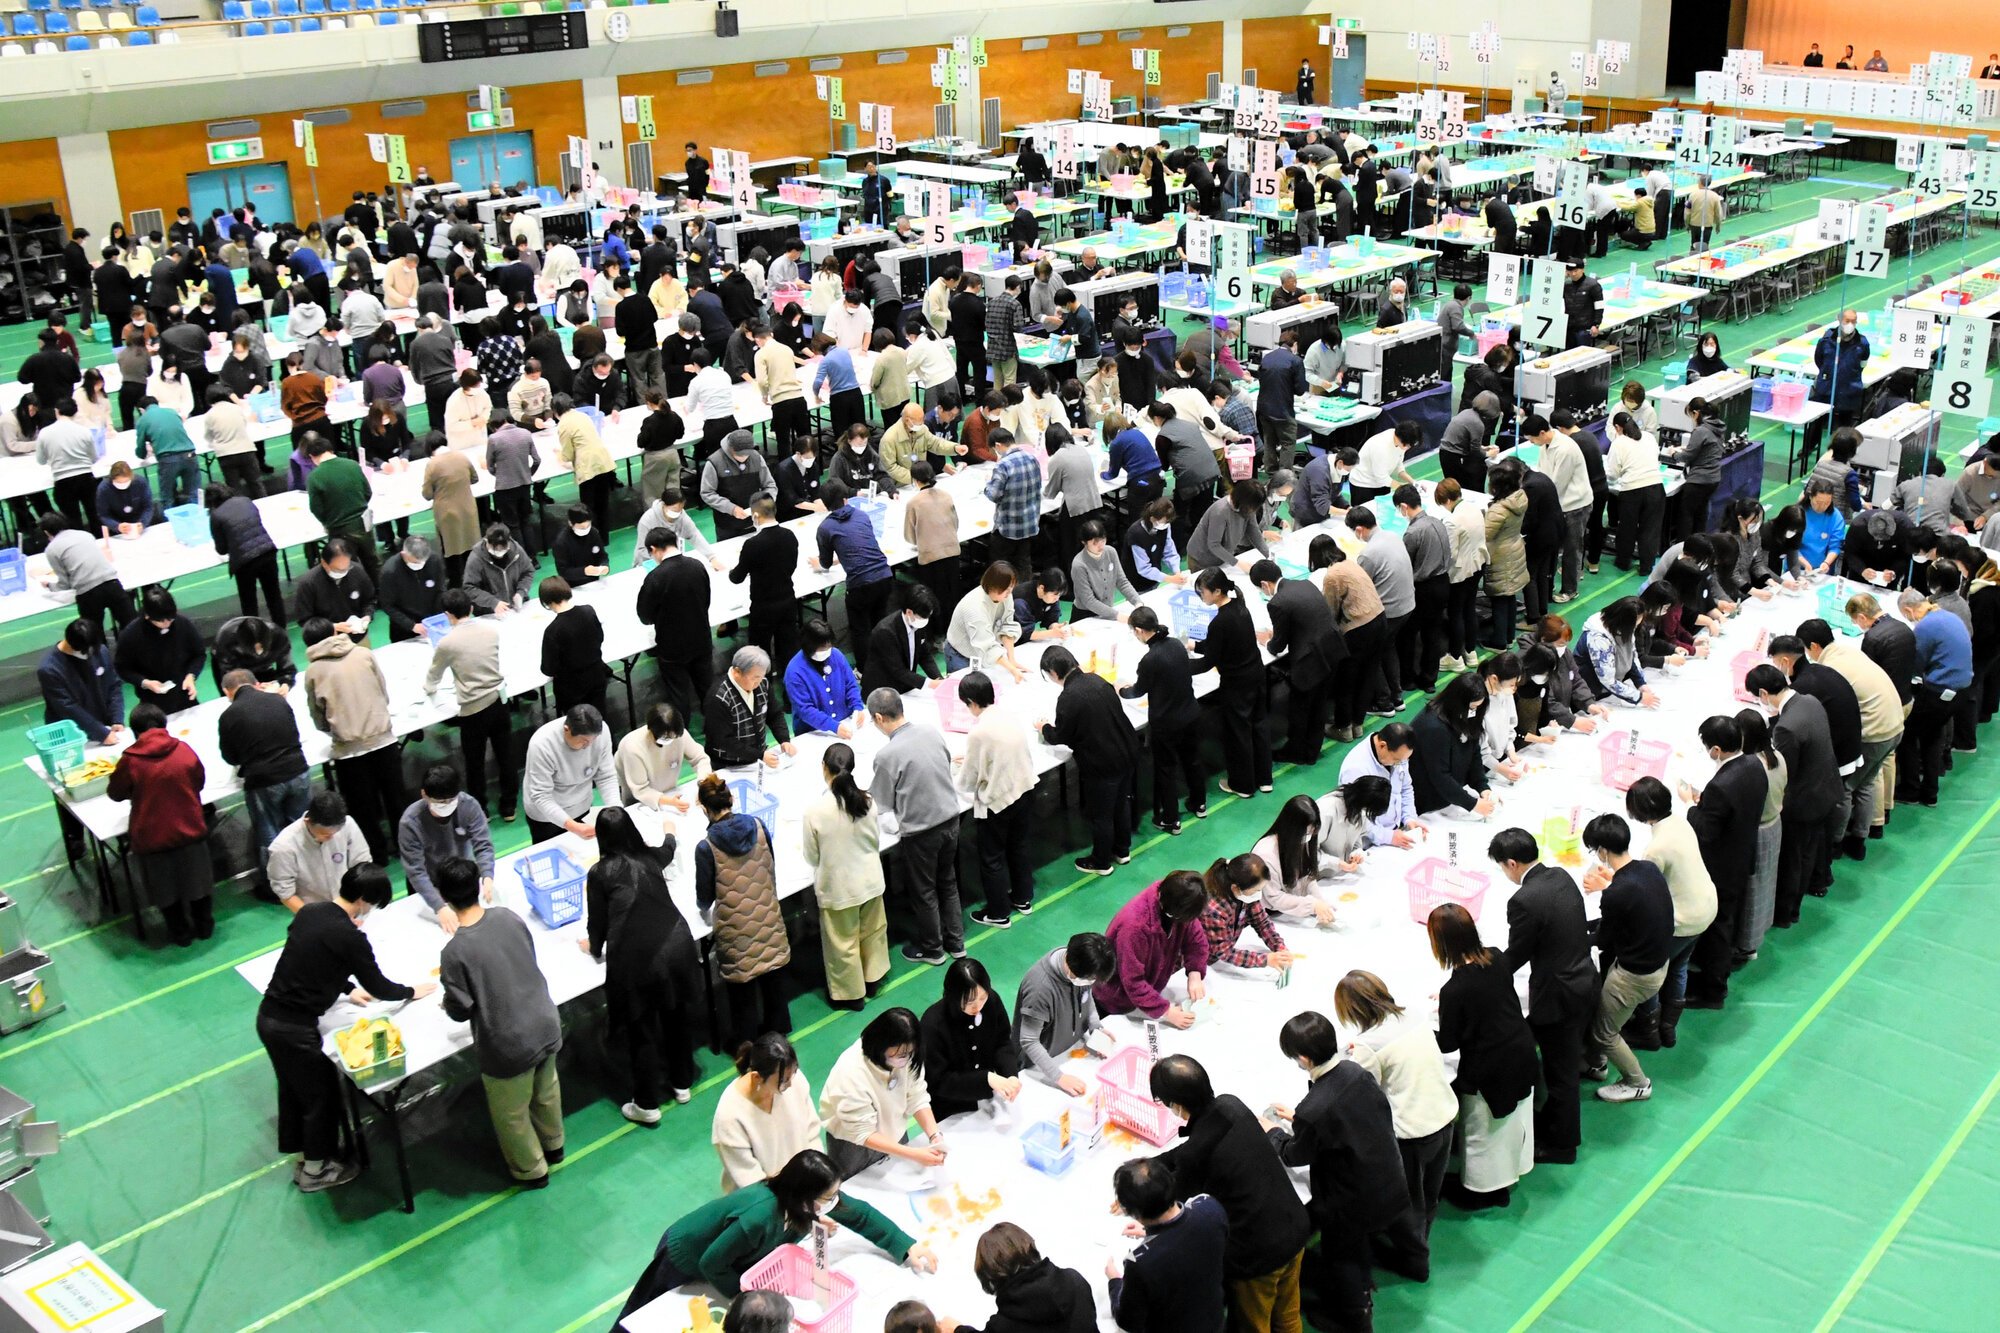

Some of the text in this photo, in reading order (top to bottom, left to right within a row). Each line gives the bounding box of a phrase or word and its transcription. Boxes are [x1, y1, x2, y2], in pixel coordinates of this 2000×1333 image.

[1335, 47, 1346, 57] 71
[1477, 53, 1490, 63] 61
[972, 55, 985, 66] 95
[1438, 60, 1449, 72] 32
[1605, 62, 1619, 73] 62
[1147, 71, 1159, 83] 93
[1584, 75, 1597, 87] 34
[944, 89, 957, 101] 92
[1740, 83, 1754, 96] 36
[832, 104, 843, 117] 91
[1097, 106, 1110, 119] 21
[1956, 103, 1973, 116] 42
[1236, 113, 1253, 127] 33
[1260, 119, 1278, 134] 22
[642, 124, 655, 138] 12
[1420, 125, 1436, 140] 35
[1446, 122, 1464, 138] 23
[879, 136, 893, 151] 13
[1680, 147, 1701, 163] 41
[1711, 150, 1734, 168] 24
[396, 166, 405, 180] 2
[1056, 159, 1073, 176] 14
[586, 173, 592, 189] 3
[1255, 177, 1276, 195] 15
[1918, 177, 1941, 195] 43
[739, 189, 749, 206] 4
[1971, 188, 1998, 207] 25
[1557, 203, 1584, 225] 16
[934, 224, 945, 244] 5
[1854, 250, 1884, 272] 17
[1494, 273, 1500, 282] 7
[1542, 265, 1553, 305] 小選挙区
[1227, 276, 1242, 297] 6
[1536, 315, 1553, 340] 7
[1899, 332, 1907, 343] 8
[1913, 320, 1928, 359] 開披台
[1960, 323, 1976, 369] 小選挙区
[1948, 380, 1972, 409] 8
[1448, 832, 1458, 867] 開披済み
[1147, 1023, 1159, 1063] 開披済み
